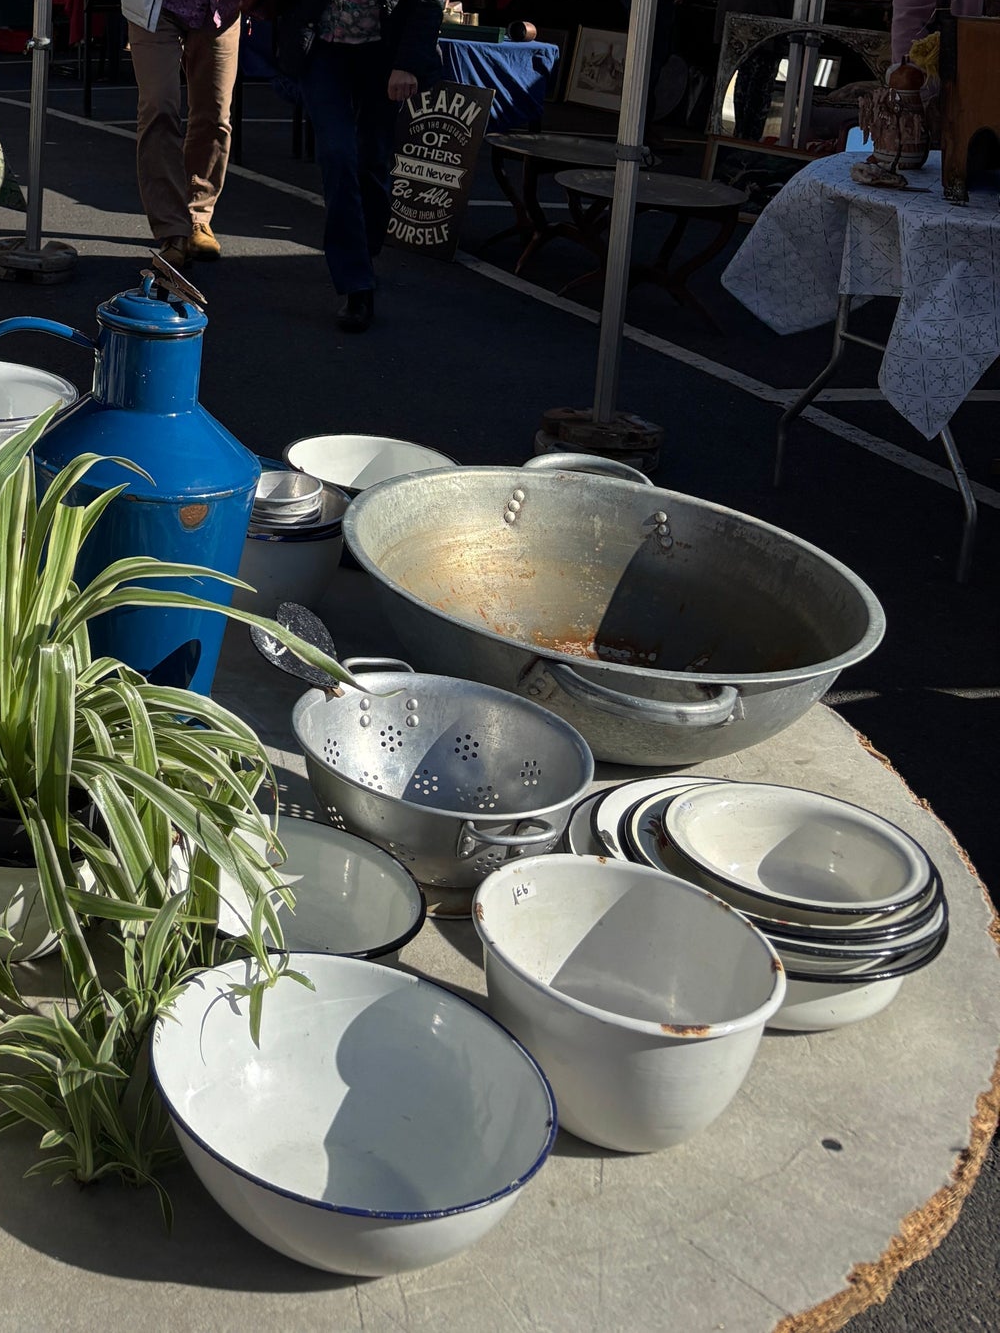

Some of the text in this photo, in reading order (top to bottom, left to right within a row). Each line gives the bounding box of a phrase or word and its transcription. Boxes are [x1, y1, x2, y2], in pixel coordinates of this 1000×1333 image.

[406, 89, 482, 127] LEARN
[422, 131, 450, 148] OF
[402, 143, 462, 165] OTHERS
[426, 167, 457, 183] Never
[392, 179, 454, 209] Be Able
[387, 218, 450, 245] OURSELF
